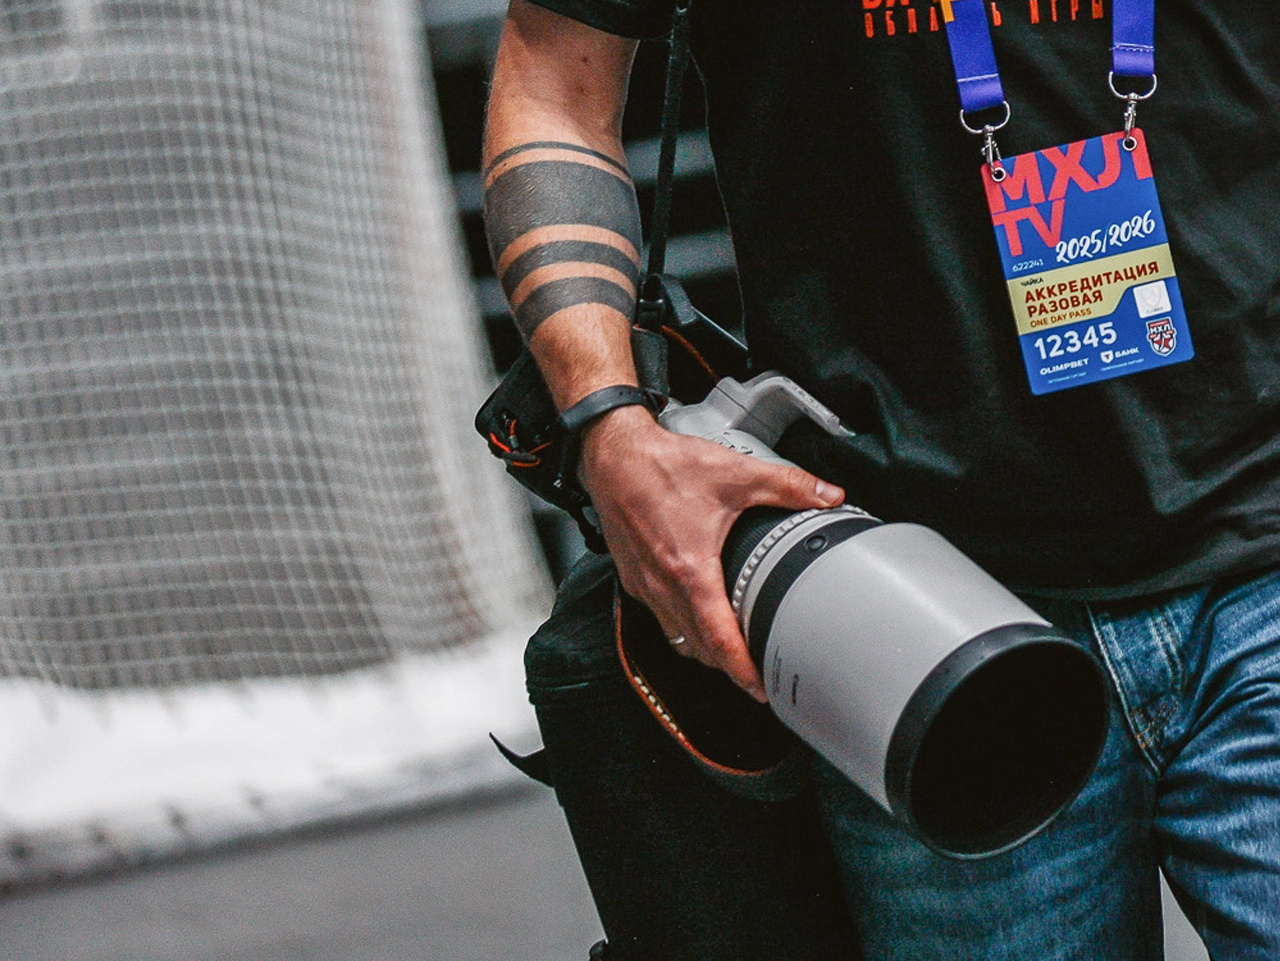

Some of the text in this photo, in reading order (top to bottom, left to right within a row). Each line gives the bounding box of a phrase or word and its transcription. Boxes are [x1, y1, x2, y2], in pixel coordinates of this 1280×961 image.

[864, 2, 1002, 38] ОБЛАЬ
[981, 128, 1153, 214] МХЛ
[993, 199, 1066, 257] TV
[1055, 210, 1156, 263] 2025/2026
[1025, 261, 1159, 303] АККРЕДИТАЦИЯ
[1027, 290, 1103, 318] РАЗОВАЯ
[1030, 308, 1092, 328] ONE DAY PASS
[1034, 321, 1117, 360] 12345
[1149, 324, 1172, 336] МХЛ
[1039, 358, 1089, 375] OLIMPBET
